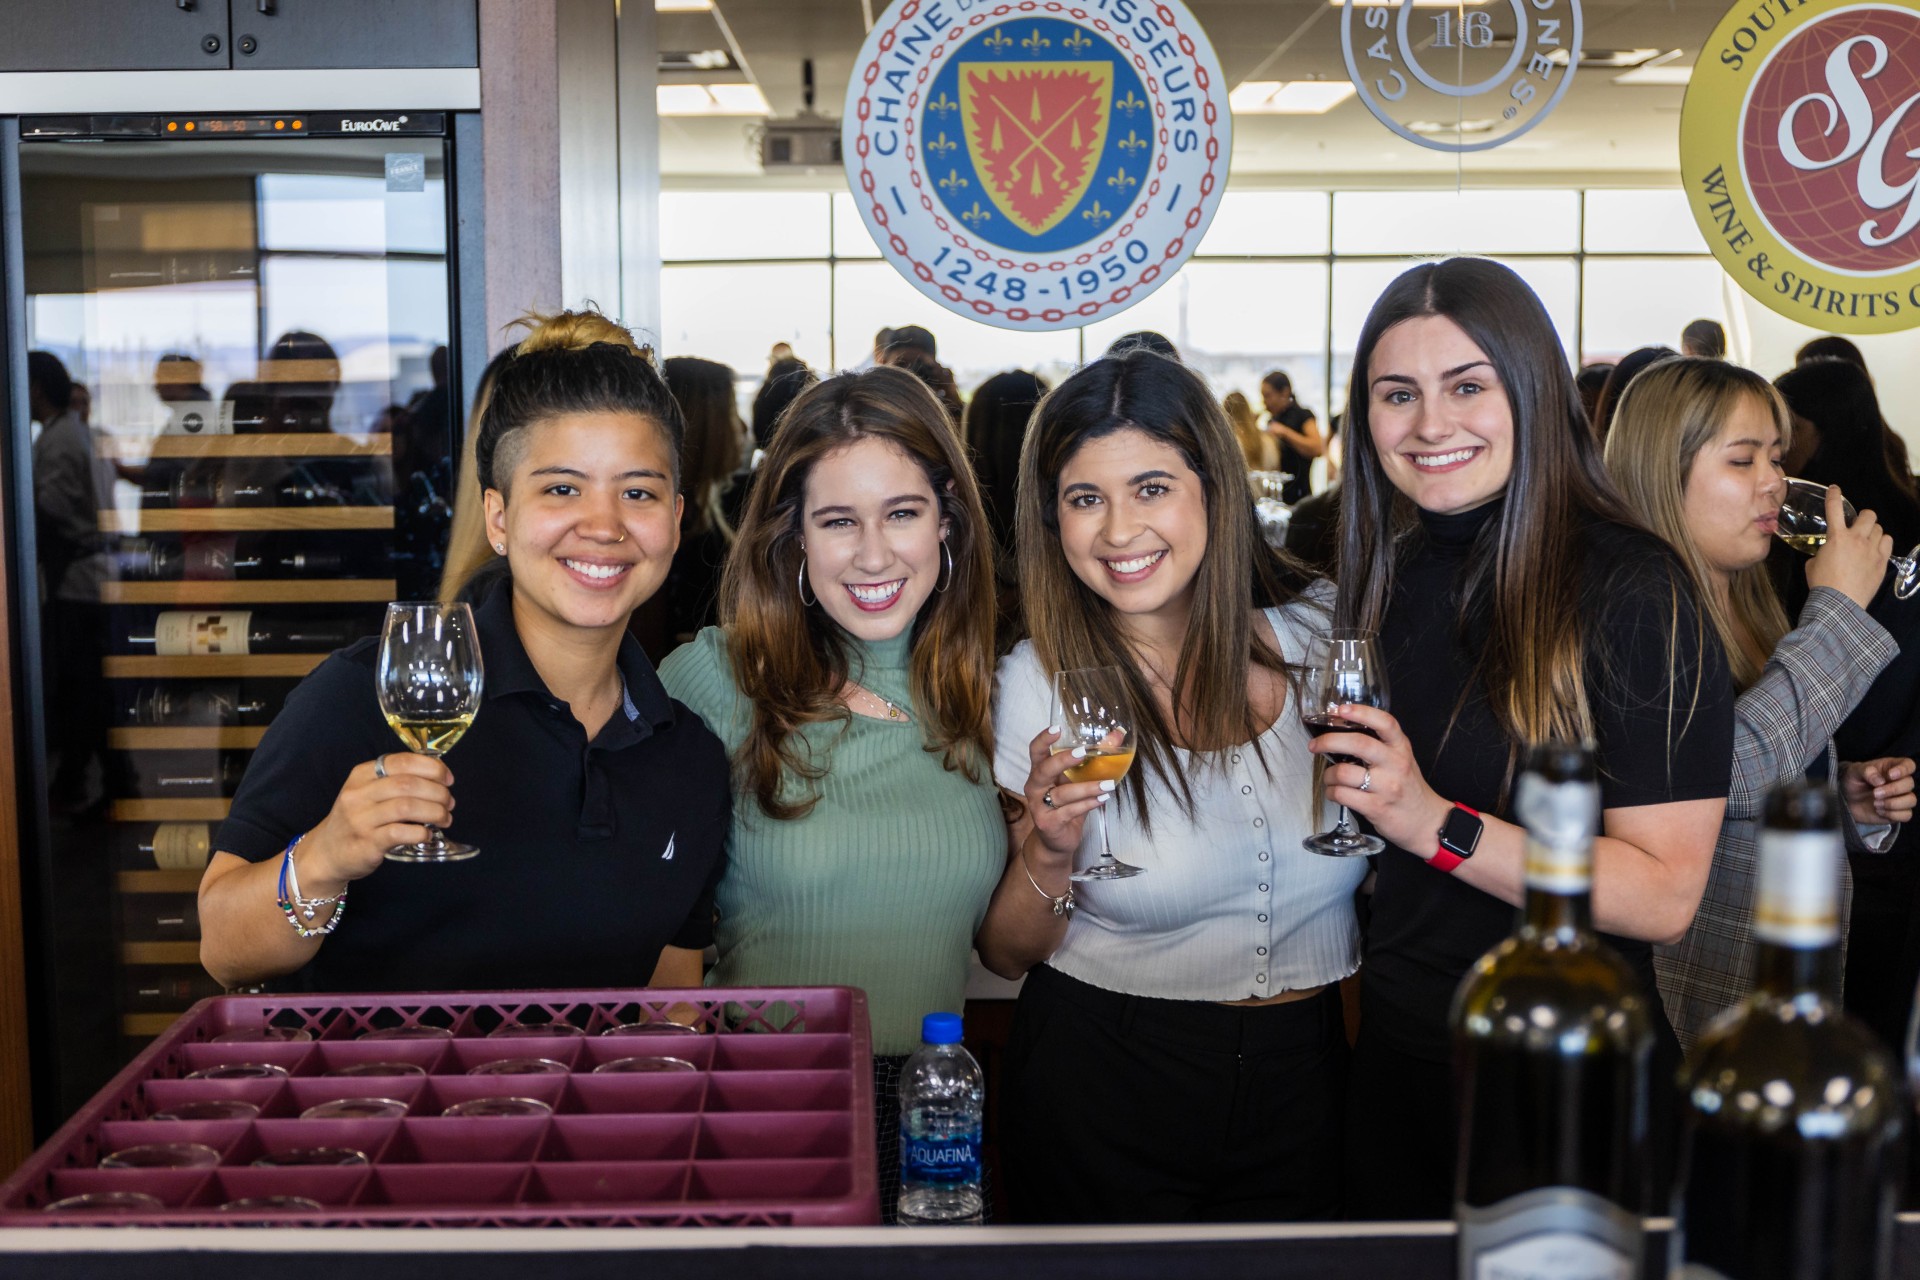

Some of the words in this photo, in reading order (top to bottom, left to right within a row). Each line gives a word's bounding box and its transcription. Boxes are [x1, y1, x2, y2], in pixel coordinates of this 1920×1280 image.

[1430, 11, 1494, 48] 16
[1720, 0, 1807, 71] SOUT
[874, 1, 954, 156] CHAINE
[1702, 163, 1755, 255] WINE
[1747, 252, 1775, 282] &
[1774, 271, 1900, 318] SPIRITS
[910, 1144, 972, 1167] AQUAFINA
